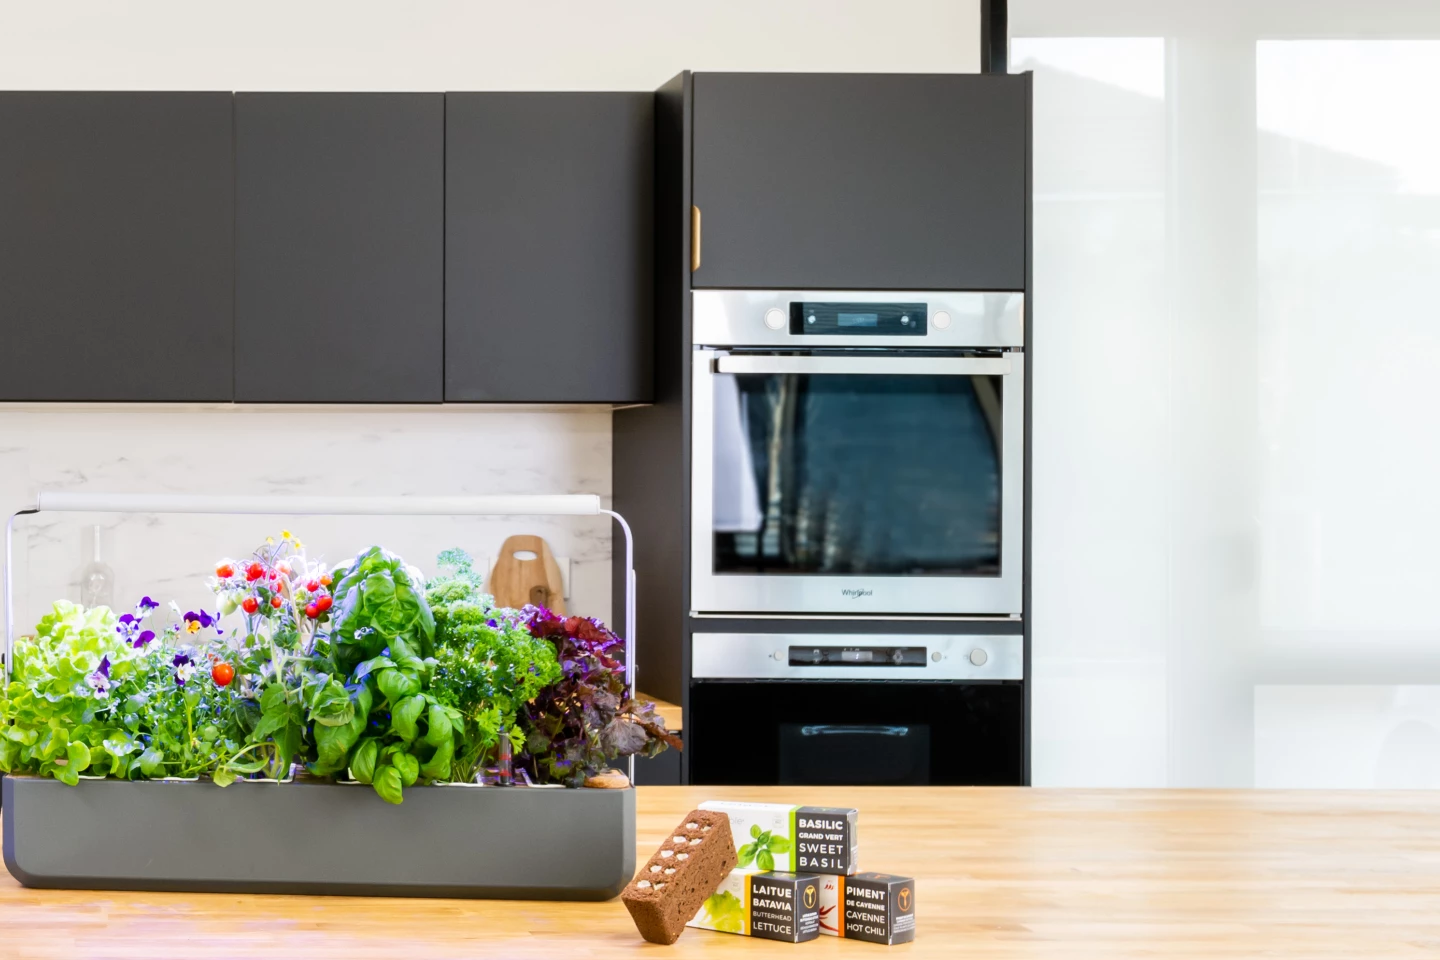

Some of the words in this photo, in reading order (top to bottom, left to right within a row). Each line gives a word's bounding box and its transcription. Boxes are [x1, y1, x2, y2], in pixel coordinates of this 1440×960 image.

[841, 588, 873, 599] Whirlpool
[799, 819, 843, 830] BASILIC
[799, 832, 823, 840] GRAND
[825, 833, 843, 841] VERT
[799, 843, 843, 855] SWEET
[799, 857, 844, 869] BASIL
[753, 884, 792, 898] LAITUE
[846, 886, 885, 900] PIMENT
[753, 898, 792, 911] BATAVIA
[856, 901, 885, 911] CAYENNE
[753, 911, 792, 922] BUTTERHEAD
[846, 910, 885, 924] CAYENNE
[753, 921, 792, 935] LETTUCE
[846, 923, 863, 932] HOT
[864, 926, 885, 936] CHILI
